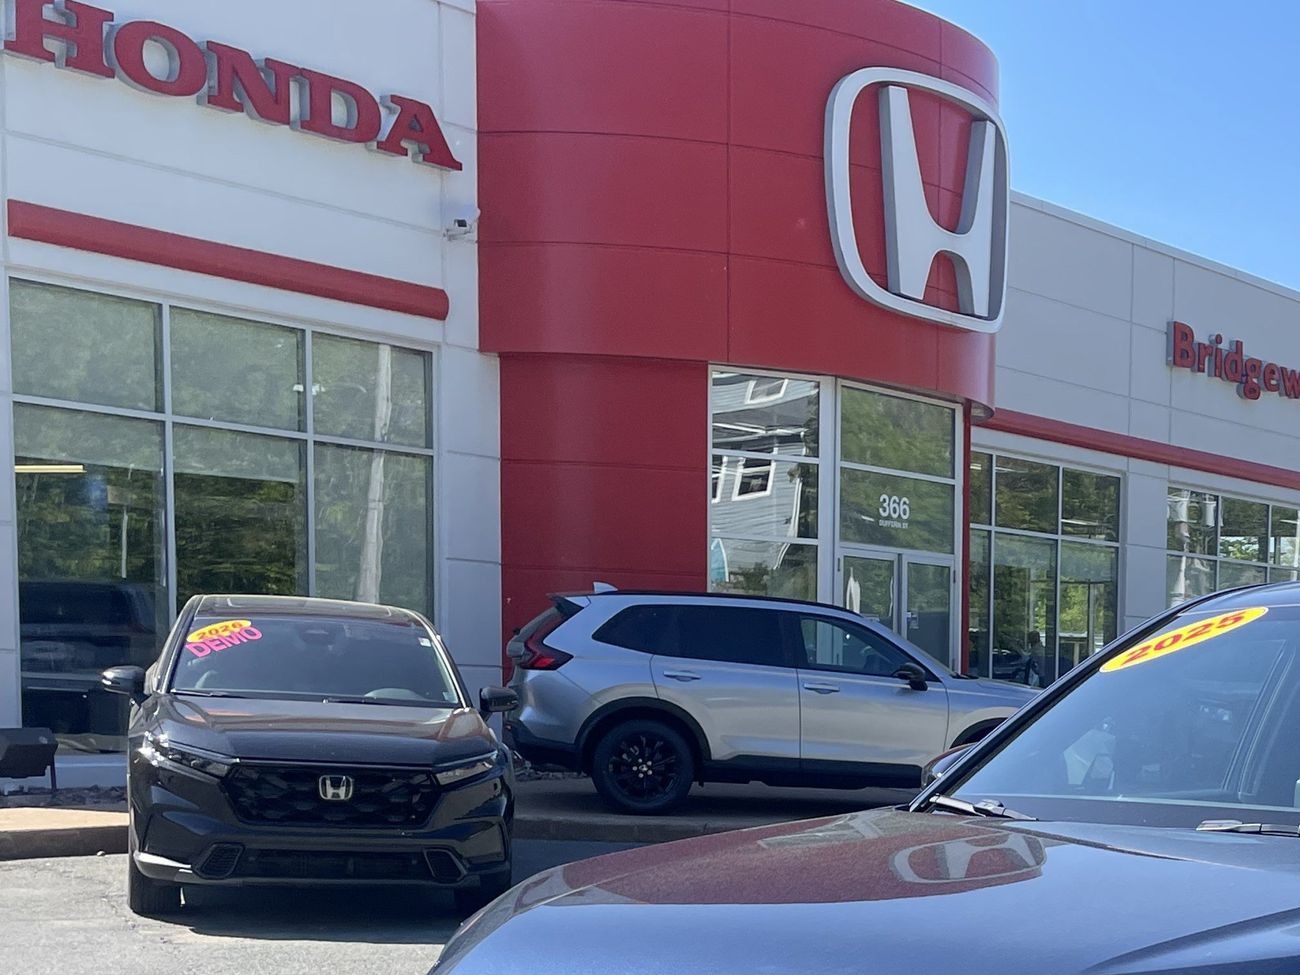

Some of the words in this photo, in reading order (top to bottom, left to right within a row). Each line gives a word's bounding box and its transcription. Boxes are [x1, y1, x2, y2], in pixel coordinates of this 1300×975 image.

[3, 0, 463, 171] HONDA
[879, 493, 910, 520] 366
[185, 626, 263, 657] DEMO
[1120, 610, 1247, 668] 2025
